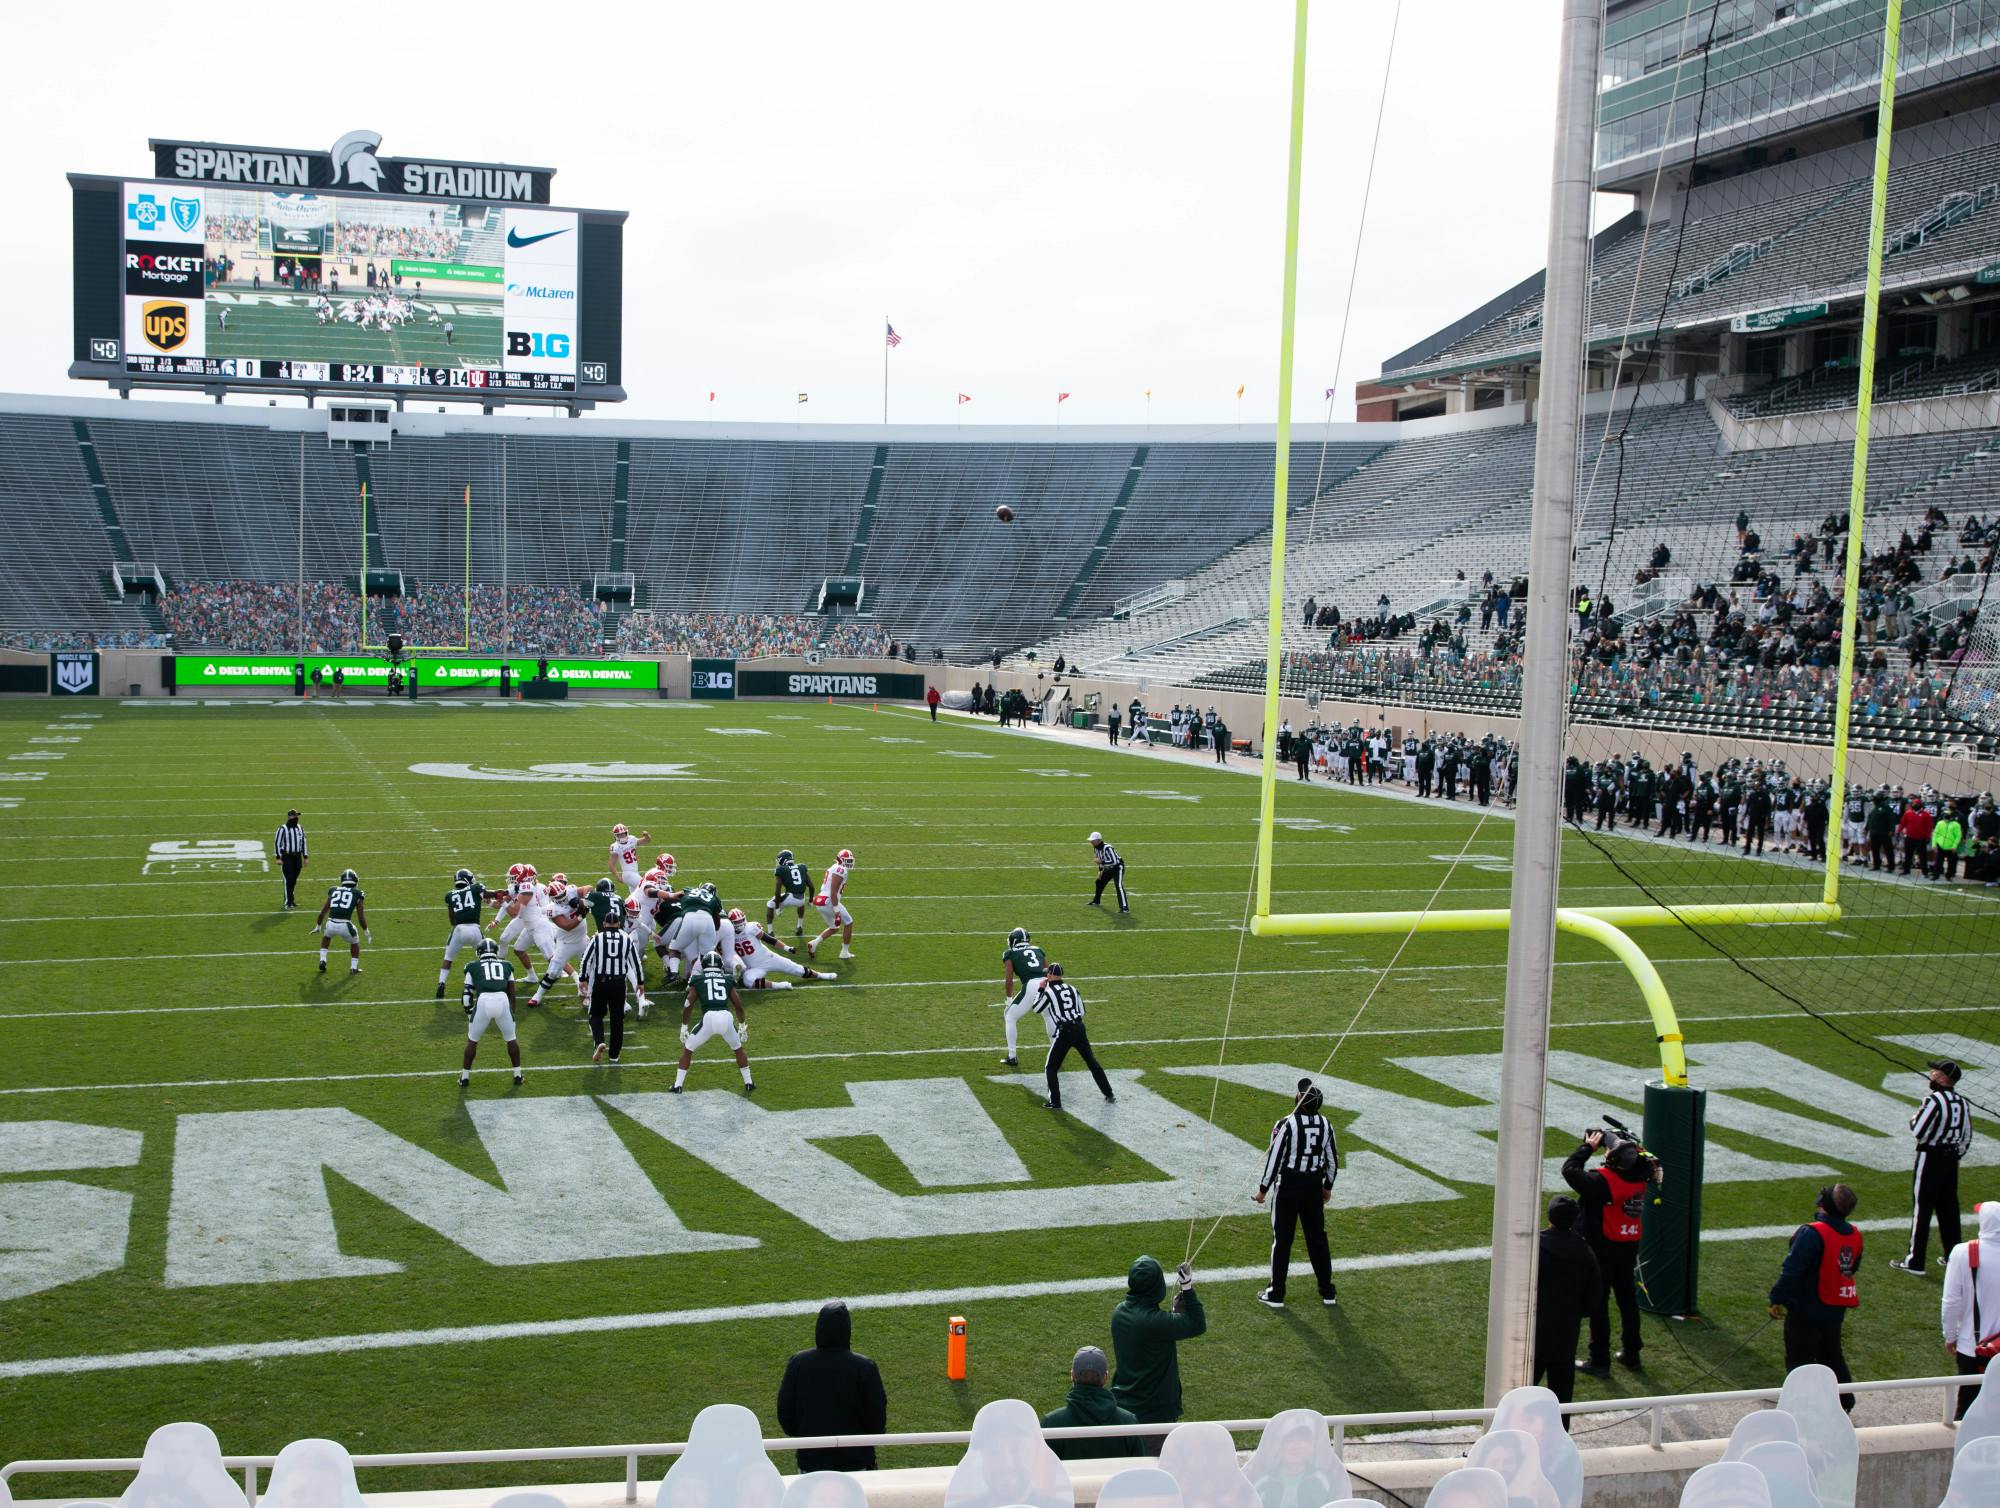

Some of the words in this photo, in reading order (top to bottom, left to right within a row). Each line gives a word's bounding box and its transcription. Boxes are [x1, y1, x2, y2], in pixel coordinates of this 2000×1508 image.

[175, 147, 309, 186] SPARTAN
[403, 164, 532, 201] STADIUM
[126, 253, 203, 273] ROCKET
[142, 270, 188, 283] Mortgage
[525, 286, 574, 300] McLaren
[147, 316, 186, 344] ups
[94, 342, 117, 359] 40
[246, 361, 253, 376] 0
[342, 364, 374, 382] 9:24
[584, 365, 604, 381] 40
[452, 371, 468, 386] 14
[219, 666, 250, 675] DELTA
[251, 667, 292, 676] DENTAL
[449, 668, 480, 678] DELTA
[562, 669, 599, 679] DELTA
[600, 669, 632, 679] DENTAL
[788, 674, 877, 695] SPARTANS
[623, 848, 638, 864] 93
[790, 869, 802, 885] 9
[329, 891, 353, 909] 29
[451, 890, 476, 912] 34
[609, 898, 621, 916] 5
[607, 939, 620, 956] U
[734, 940, 755, 957] 66
[1023, 949, 1040, 968] 3
[480, 962, 504, 981] 10
[704, 978, 727, 1001] 15
[1061, 989, 1074, 1010] S
[1950, 1102, 1961, 1130] B
[1304, 1127, 1320, 1155] F
